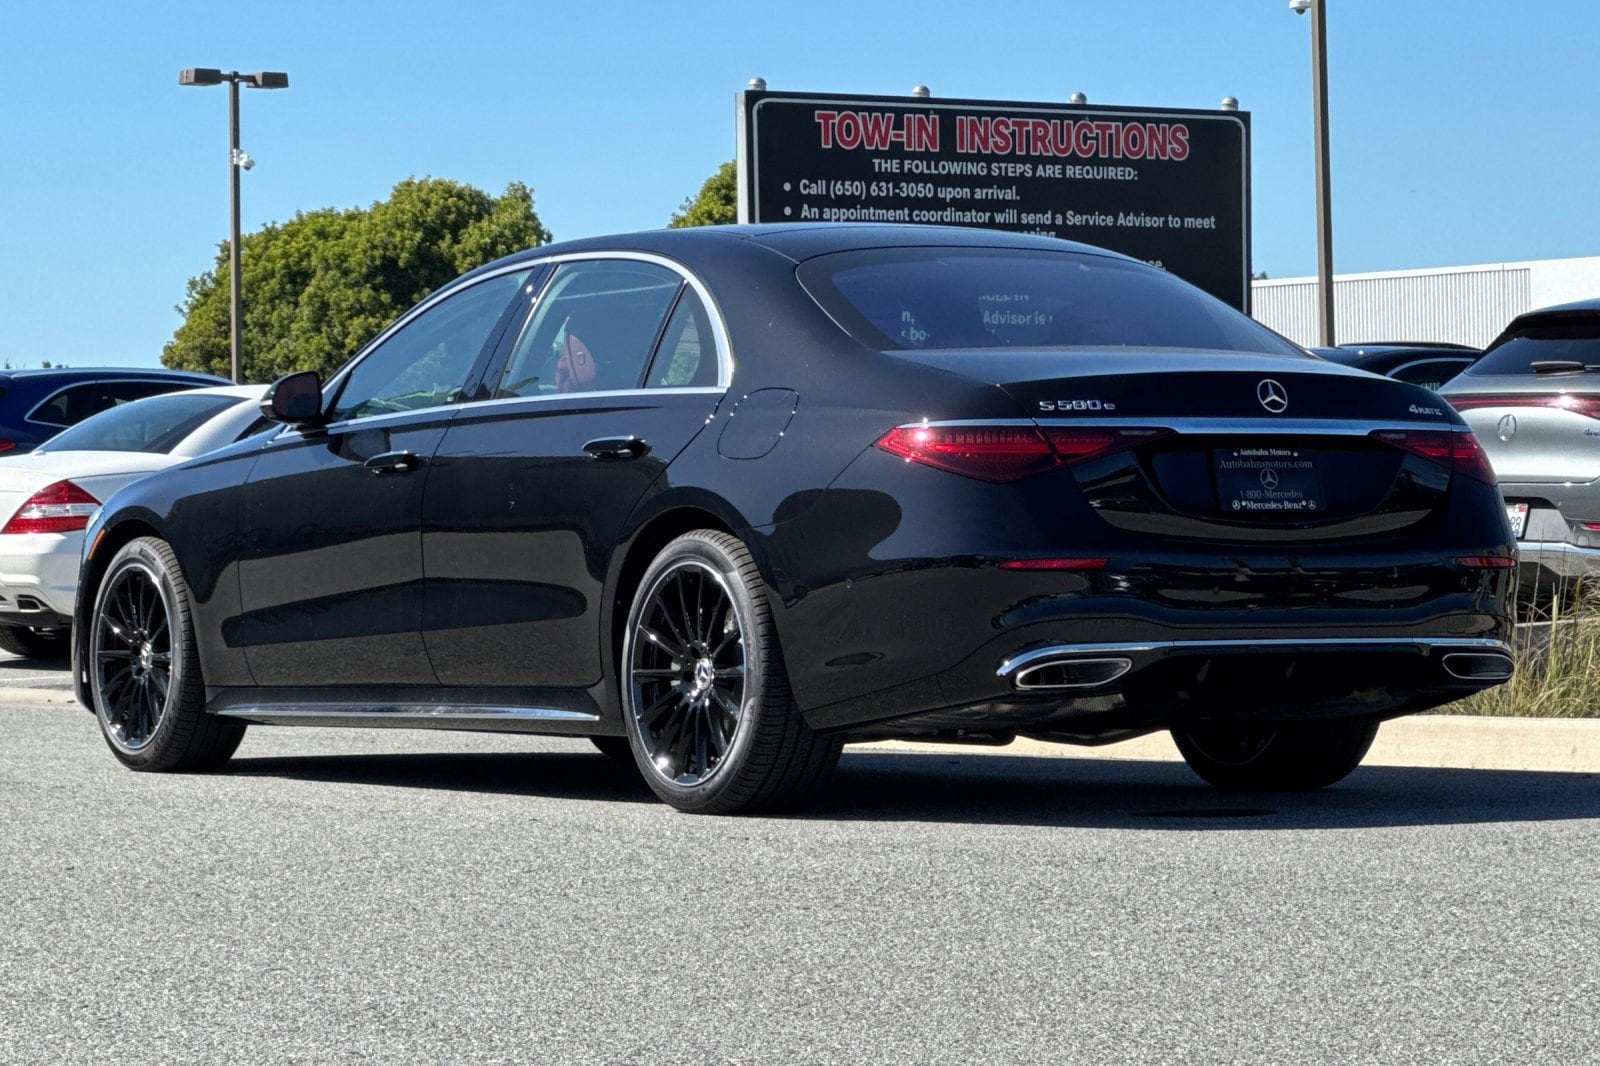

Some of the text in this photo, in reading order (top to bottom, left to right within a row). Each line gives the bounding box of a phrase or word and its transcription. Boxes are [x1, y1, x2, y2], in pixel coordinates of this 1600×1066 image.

[815, 110, 1189, 161] TOW-IN INSTRUCTIONS
[872, 159, 1138, 180] THE FOLLOWING STEPS ARE REQUIRED:
[800, 179, 1020, 202] Call (650) 631-3050 upon arrival.
[801, 204, 1216, 229] An appointment coordinator will send a Service Advisor to meet
[1039, 400, 1055, 411] S
[1240, 448, 1291, 456] Autobahn Motors
[1220, 459, 1313, 469] Autobahnmotors.com
[1240, 489, 1303, 499] 1-800-Mercedes
[1246, 500, 1302, 510] Mercedes-Benz
